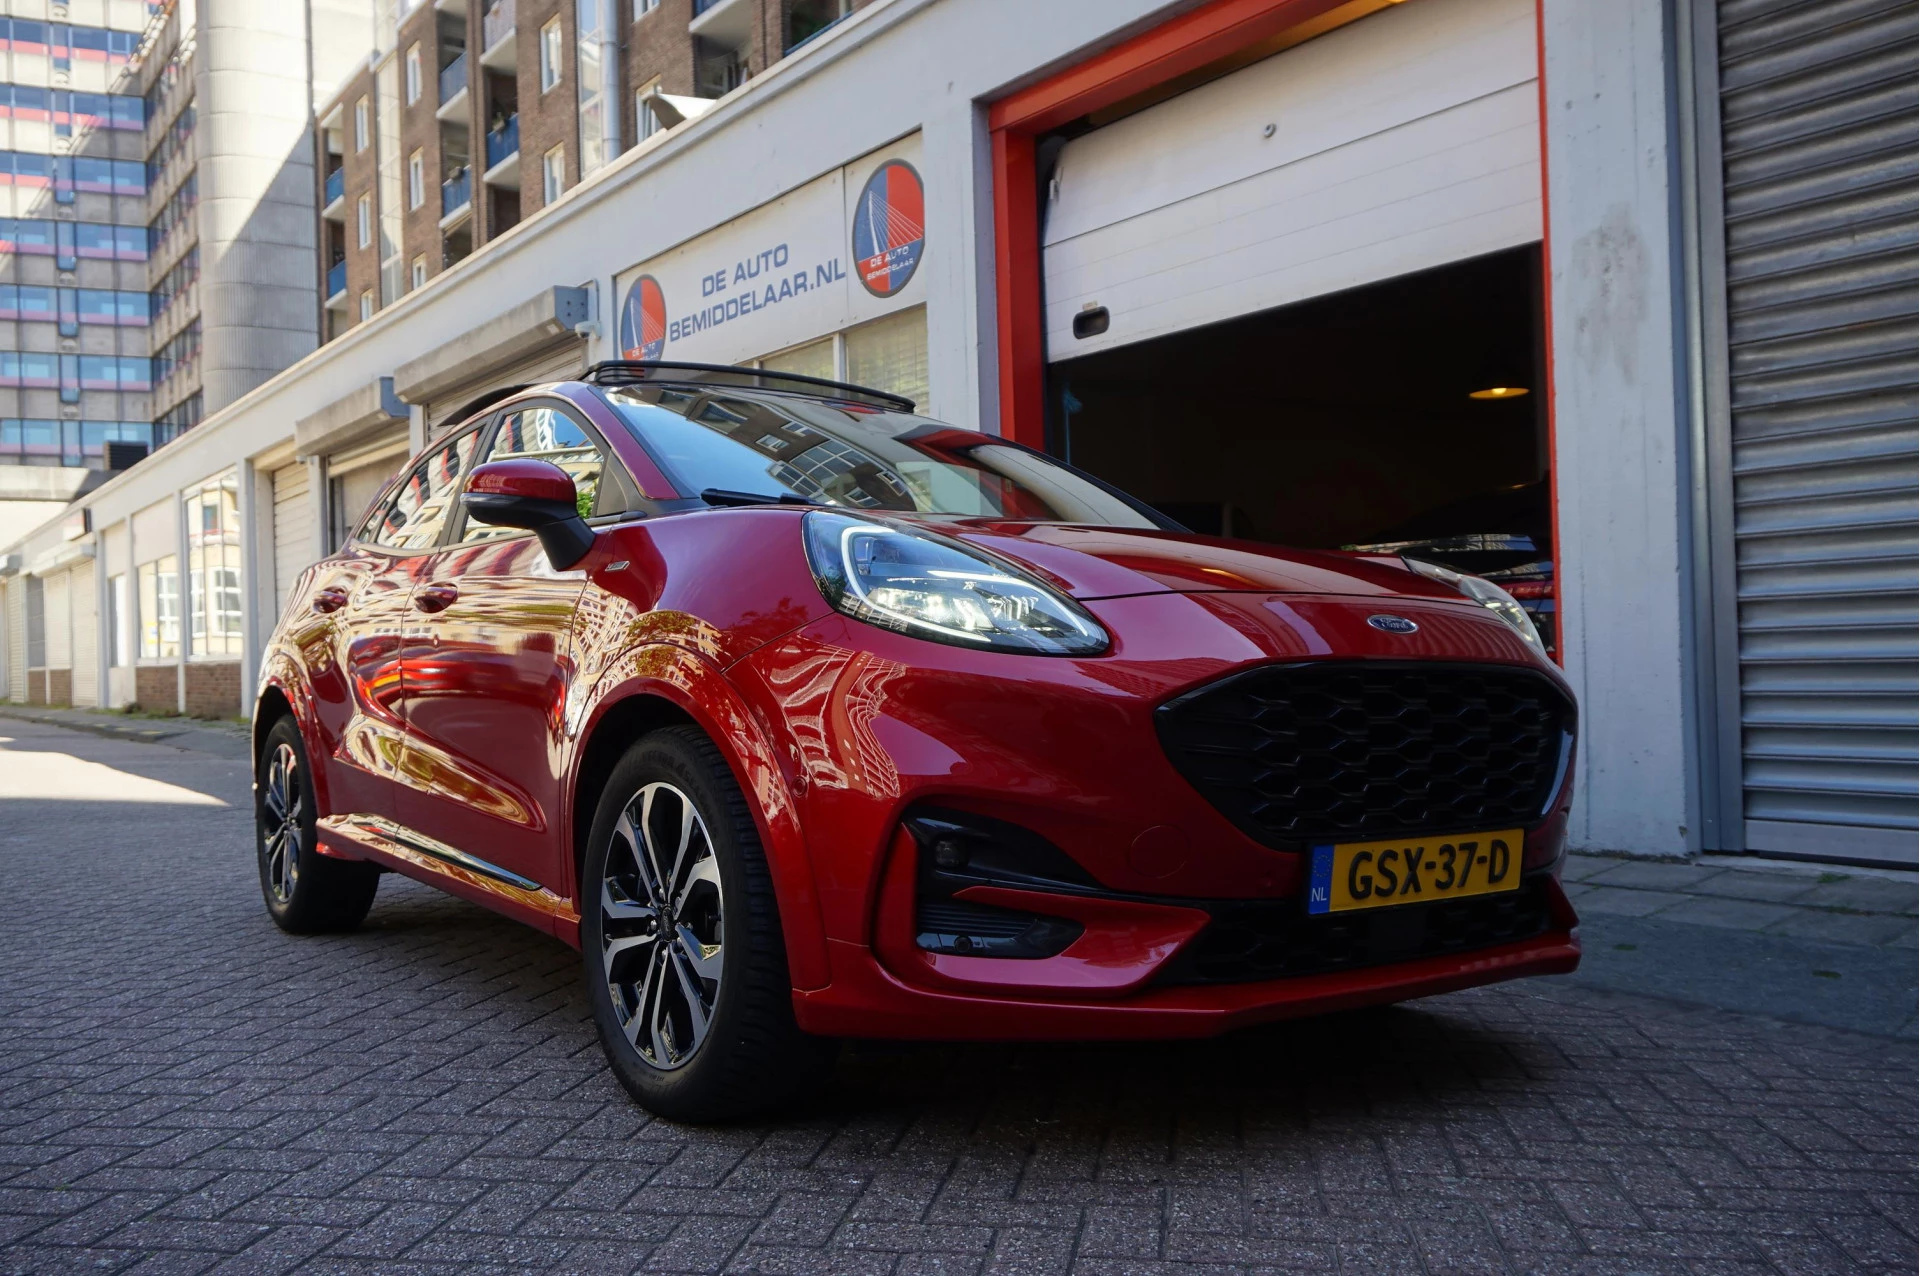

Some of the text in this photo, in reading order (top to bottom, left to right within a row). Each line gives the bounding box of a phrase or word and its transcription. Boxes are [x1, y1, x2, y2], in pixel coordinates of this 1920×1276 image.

[702, 243, 788, 297] DE AUTO
[867, 258, 913, 280] BEMIDDELAAR
[870, 246, 909, 268] DE AUTO
[669, 258, 846, 342] BEMIDDELAAR.NL
[1348, 839, 1510, 900] GSX-37-D
[1311, 887, 1327, 902] NL
